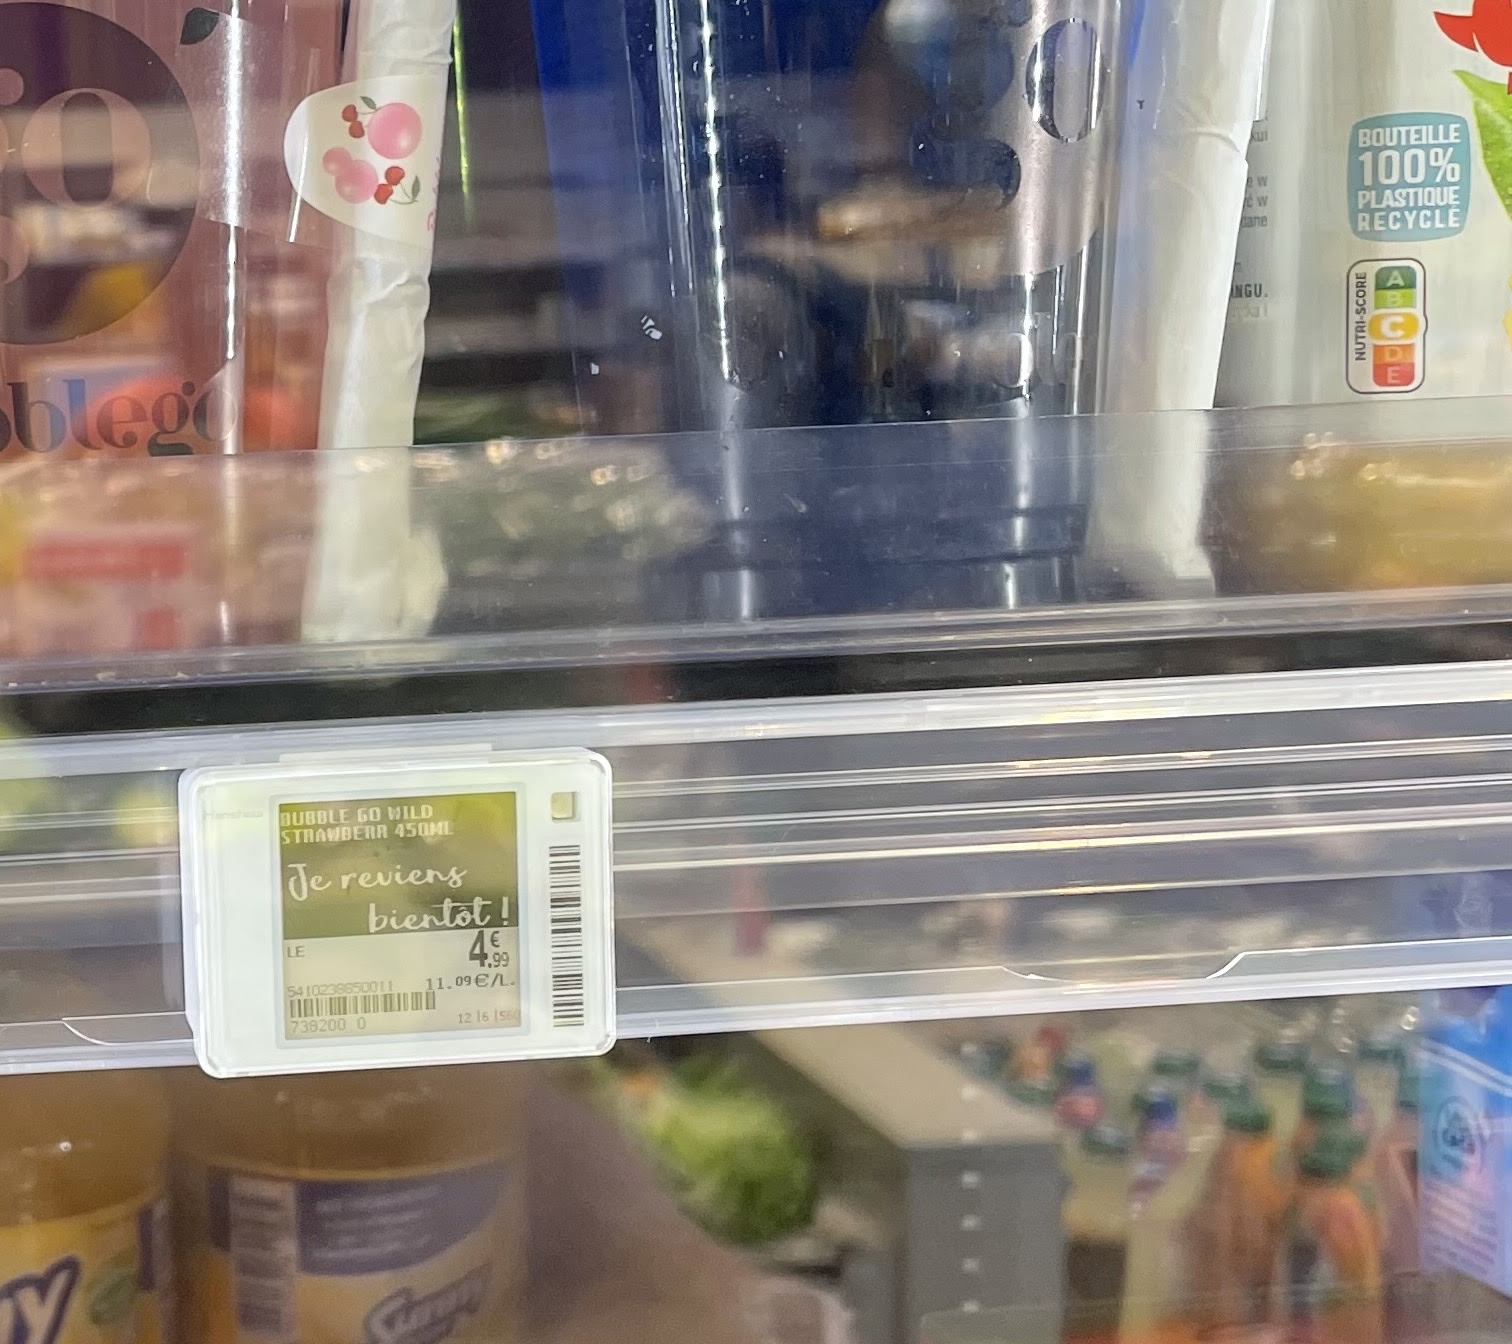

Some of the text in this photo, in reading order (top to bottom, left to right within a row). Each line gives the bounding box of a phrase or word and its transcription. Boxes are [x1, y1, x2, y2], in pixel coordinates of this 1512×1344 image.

[1357, 123, 1462, 149] BOUTEILLE
[1357, 147, 1462, 187] 100%
[1356, 185, 1461, 210] PLASTIQUE
[1356, 206, 1461, 232] RECYCLÉ
[1387, 269, 1405, 286] A
[1355, 271, 1367, 362] NUTRI-SCORE
[1380, 316, 1406, 338] C
[1384, 346, 1404, 362] D
[1386, 367, 1401, 384] E
[280, 804, 434, 827] BUBBLE GO WILD
[281, 820, 454, 845] STRAWBERR 450ML
[287, 862, 468, 902] Je reviens
[368, 896, 492, 934] bientôt
[287, 945, 305, 958] LE
